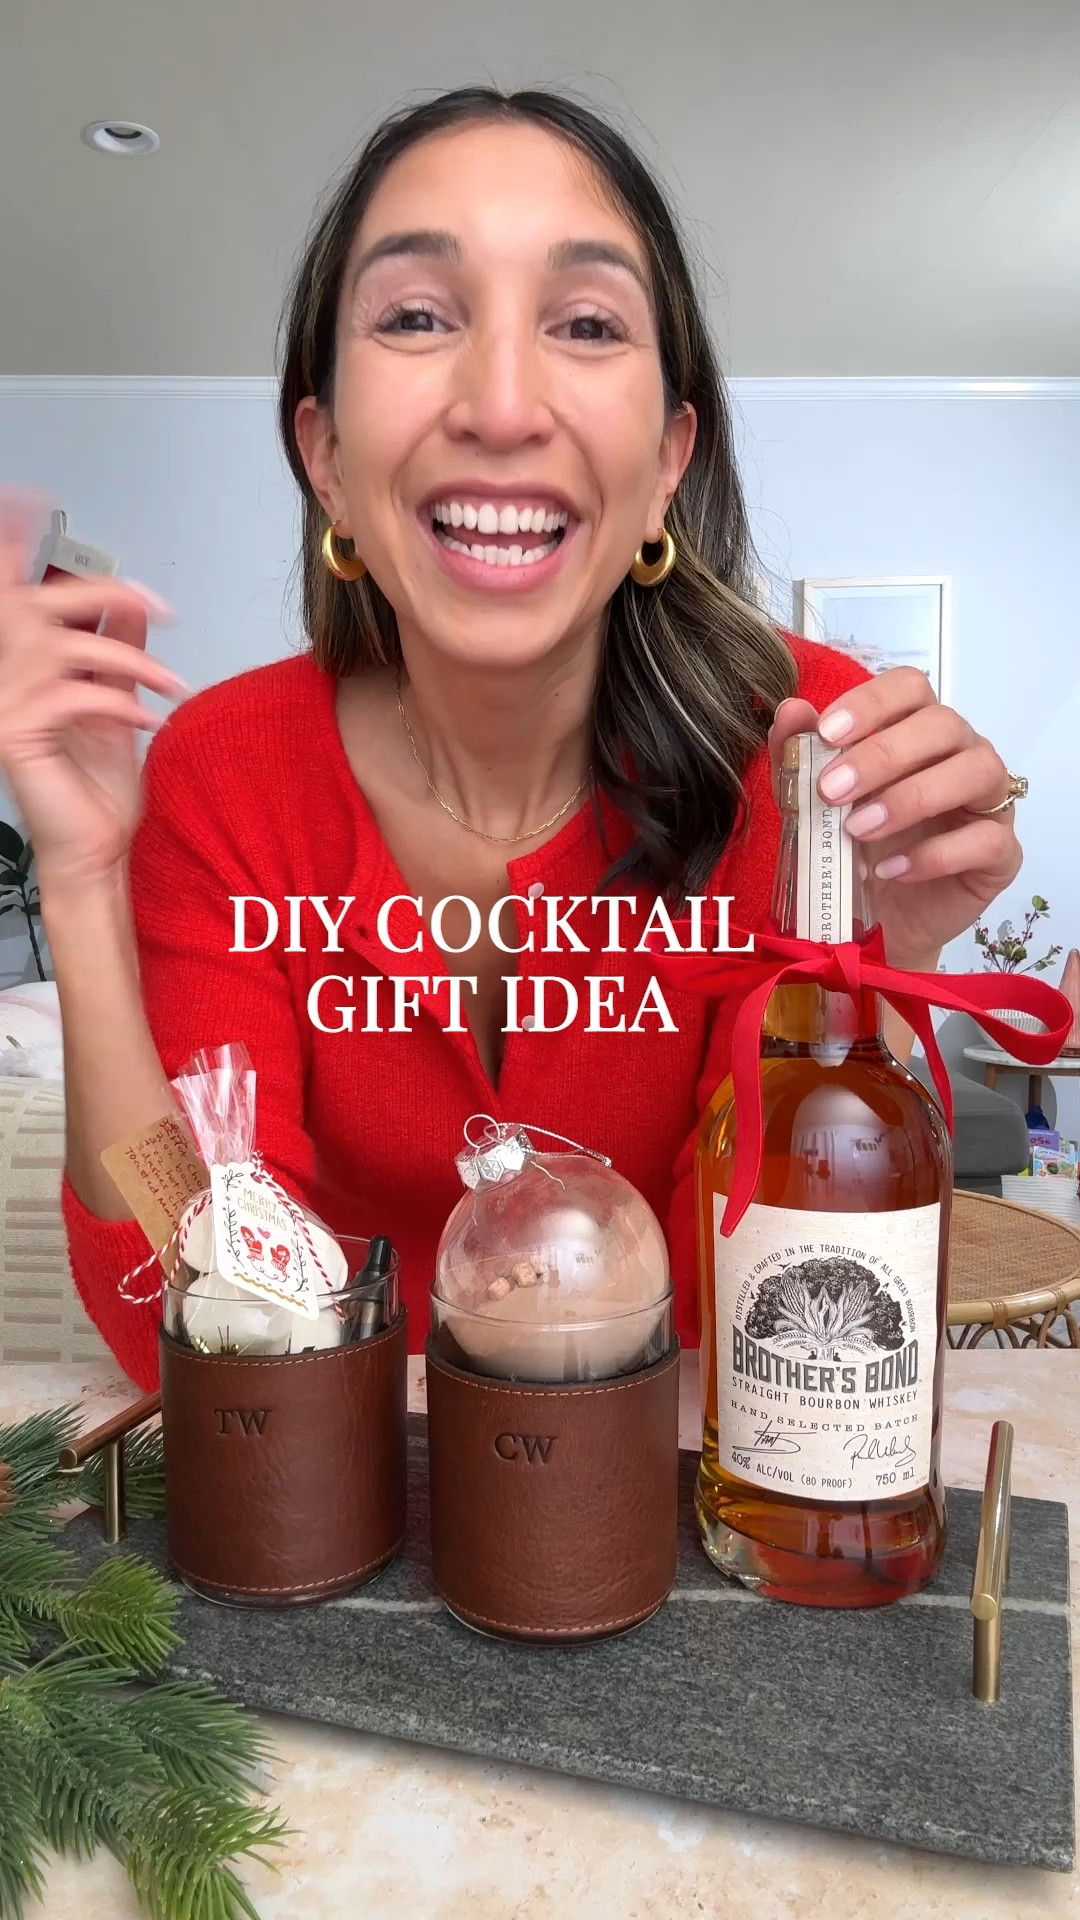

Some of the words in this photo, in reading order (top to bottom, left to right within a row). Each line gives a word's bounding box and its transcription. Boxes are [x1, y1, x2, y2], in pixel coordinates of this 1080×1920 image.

[822, 809, 834, 850] BOND
[821, 855, 833, 942] BROTHER'S
[237, 1196, 287, 1231] CHRISTMAS
[243, 1187, 277, 1213] MERRY
[735, 1280, 751, 1321] DISTILLED
[748, 1272, 755, 1281] &
[753, 1252, 782, 1275] CRAFTED
[784, 1247, 796, 1257] IN
[798, 1244, 815, 1254] THE
[820, 1244, 867, 1261] TRADITION
[868, 1255, 880, 1265] OF
[880, 1263, 893, 1277] ALL
[893, 1275, 909, 1297] GREAT
[904, 1298, 916, 1334] BOURBON
[732, 1323, 857, 1394] BROTHER'S
[865, 1338, 919, 1393] BOND
[732, 1376, 789, 1404] STRAIGHT
[799, 1395, 861, 1410] BOURBON
[869, 1389, 918, 1409] WHISKEY
[213, 1408, 273, 1437] TW
[730, 1399, 769, 1420] HAND
[776, 1415, 866, 1432] SELECTED
[873, 1413, 919, 1431] BATCH
[493, 1431, 558, 1465] CW
[731, 1450, 751, 1470] 40%
[756, 1462, 795, 1483] ALC/VOL
[801, 1473, 817, 1487] (80
[821, 1477, 853, 1489] PROOF)
[875, 1472, 897, 1487] 750
[902, 1466, 916, 1480] ml
